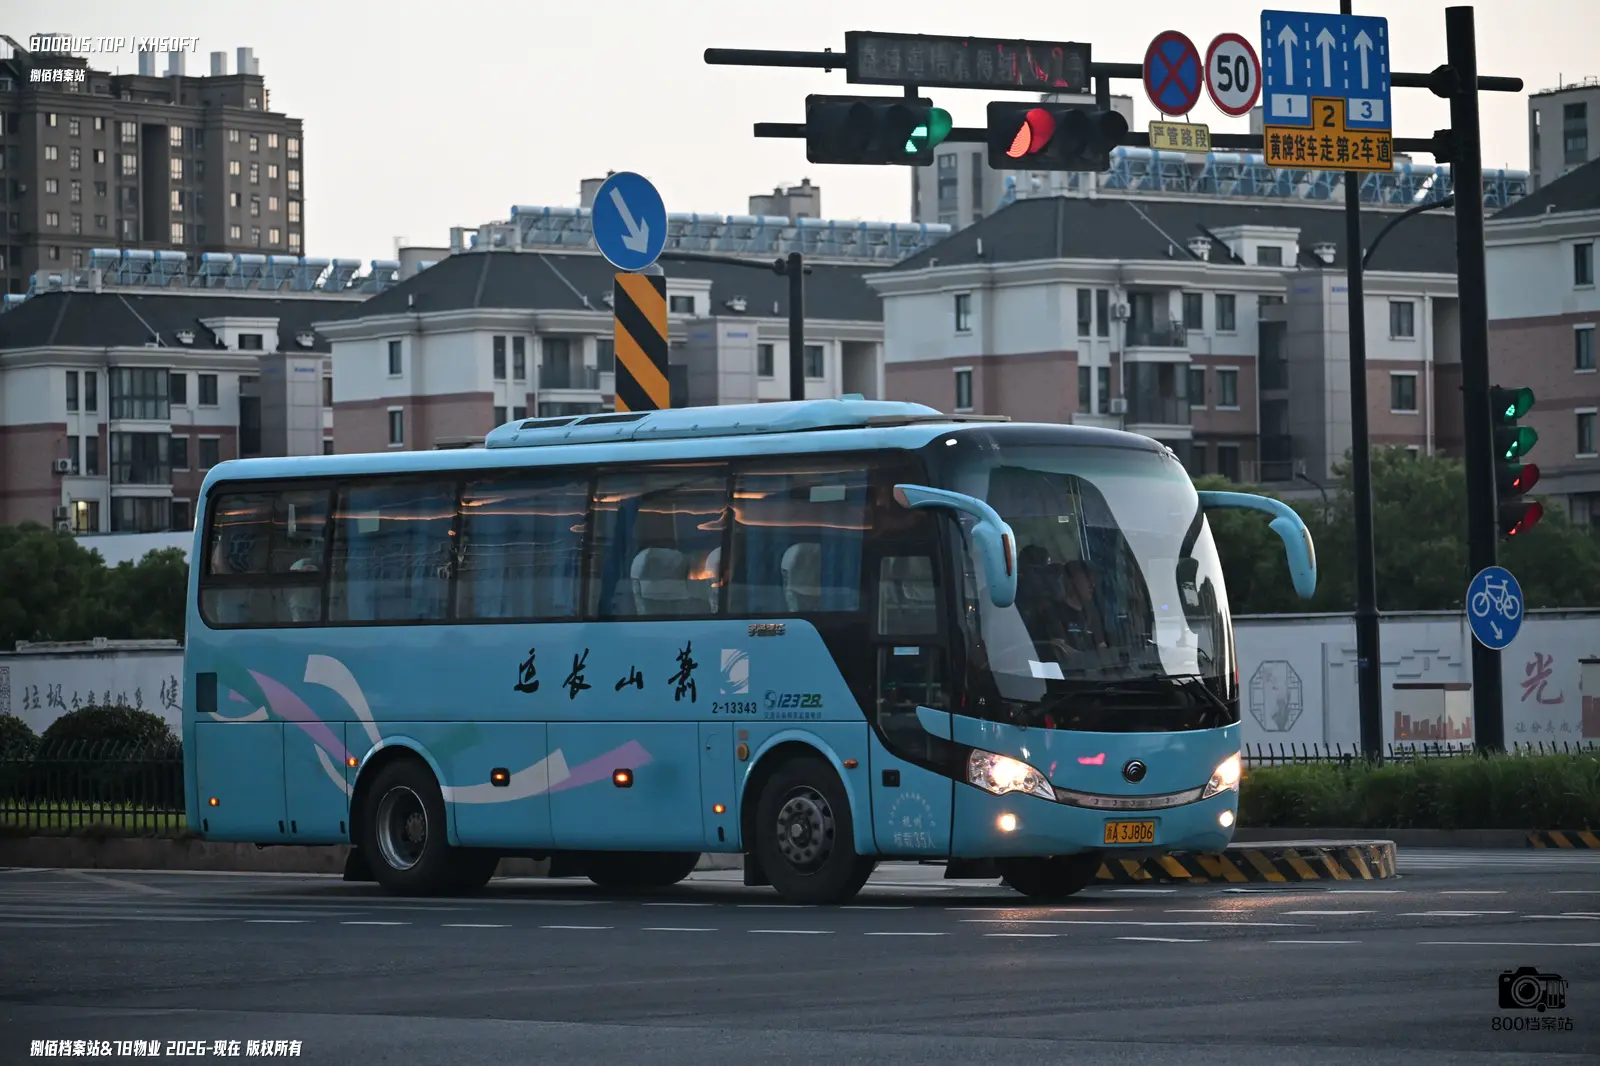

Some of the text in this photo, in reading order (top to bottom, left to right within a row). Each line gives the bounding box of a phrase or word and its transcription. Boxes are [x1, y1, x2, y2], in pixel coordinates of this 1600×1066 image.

[1216, 55, 1249, 93] 50
[1286, 98, 1292, 113] 1
[1361, 101, 1372, 119] 3
[1322, 105, 1335, 127] 2
[1152, 125, 1207, 147] 严管路段
[1270, 134, 1391, 163] 黄牌货车走第2车道
[712, 702, 757, 714] 2-13343
[777, 693, 823, 708] 12328
